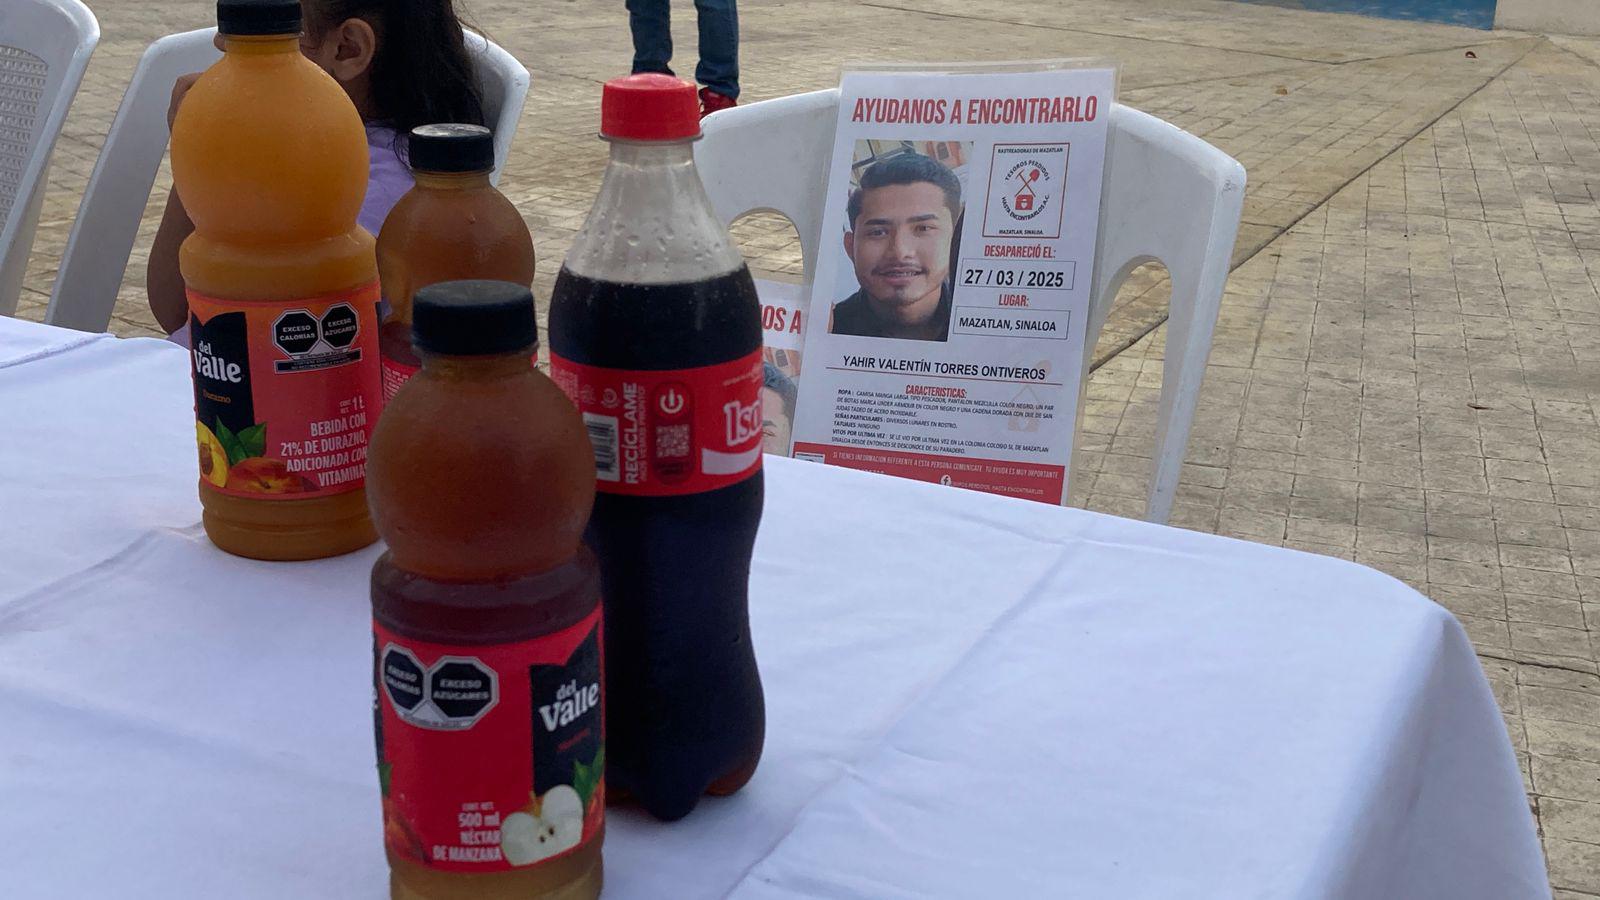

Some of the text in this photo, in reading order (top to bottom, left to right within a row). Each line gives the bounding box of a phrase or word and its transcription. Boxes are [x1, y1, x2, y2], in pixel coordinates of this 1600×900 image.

[852, 96, 1097, 124] AYUDANOS A ENCONTRARLO
[1004, 160, 1050, 181] TESOROS PERDIDOS
[1002, 196, 1011, 214] HASTA
[1010, 204, 1045, 221] ENCONTRARLOS
[984, 244, 1056, 258] DESAPARECIÓ EL:
[964, 269, 1064, 287] 27 / 03 / 2025
[998, 294, 1030, 307] LUGAR:
[328, 318, 352, 328] EXCESO
[759, 304, 801, 335] OS A
[960, 317, 1056, 332] MAZATLAN, SINALOA
[283, 325, 311, 333] EXCESO
[199, 340, 212, 356] del
[193, 349, 242, 384] Valle
[843, 355, 1046, 380] YAHIR VALENTÍN TORRES ONTIVEROS
[906, 385, 967, 399] CARACTERISTICAS:
[353, 397, 358, 410] 1
[311, 412, 366, 437] BEBIDA CON
[621, 382, 639, 485] RECÍCLAME
[281, 430, 367, 456] 21% DE DURAZNO,
[832, 436, 851, 444] SINALOA
[866, 439, 891, 447] ENTONCES
[287, 452, 349, 472] ADICIONADA
[439, 679, 482, 689] EXCESO
[556, 679, 577, 700] del
[539, 682, 599, 733] Valle
[458, 811, 500, 828] 500 ml
[433, 845, 503, 863] DE MANZANA
